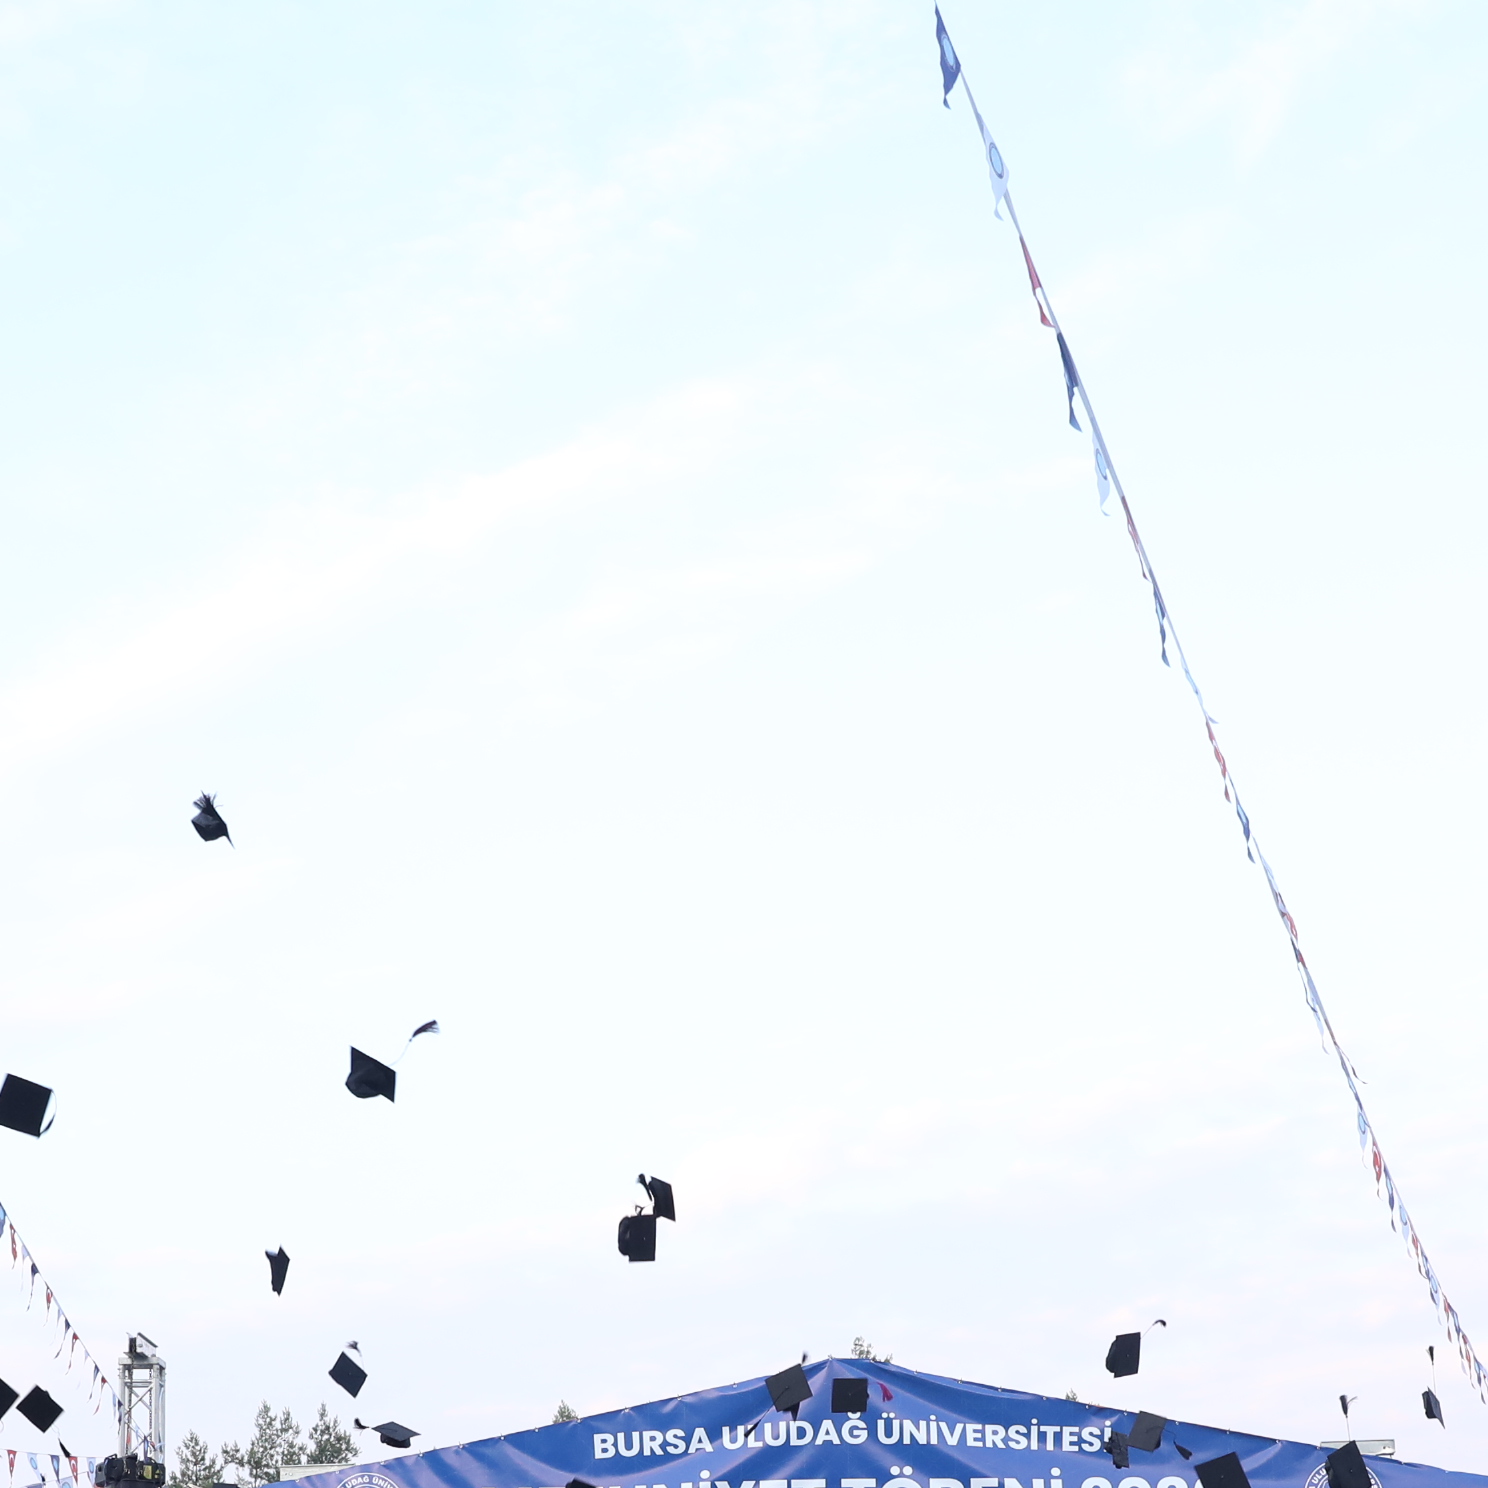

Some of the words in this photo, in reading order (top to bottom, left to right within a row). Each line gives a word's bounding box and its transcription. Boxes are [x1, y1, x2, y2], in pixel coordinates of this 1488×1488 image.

[593, 1427, 714, 1460] BURSA
[721, 1411, 868, 1450] ULUDAĞ
[877, 1412, 1112, 1453] ÜNİVERSİTESİ
